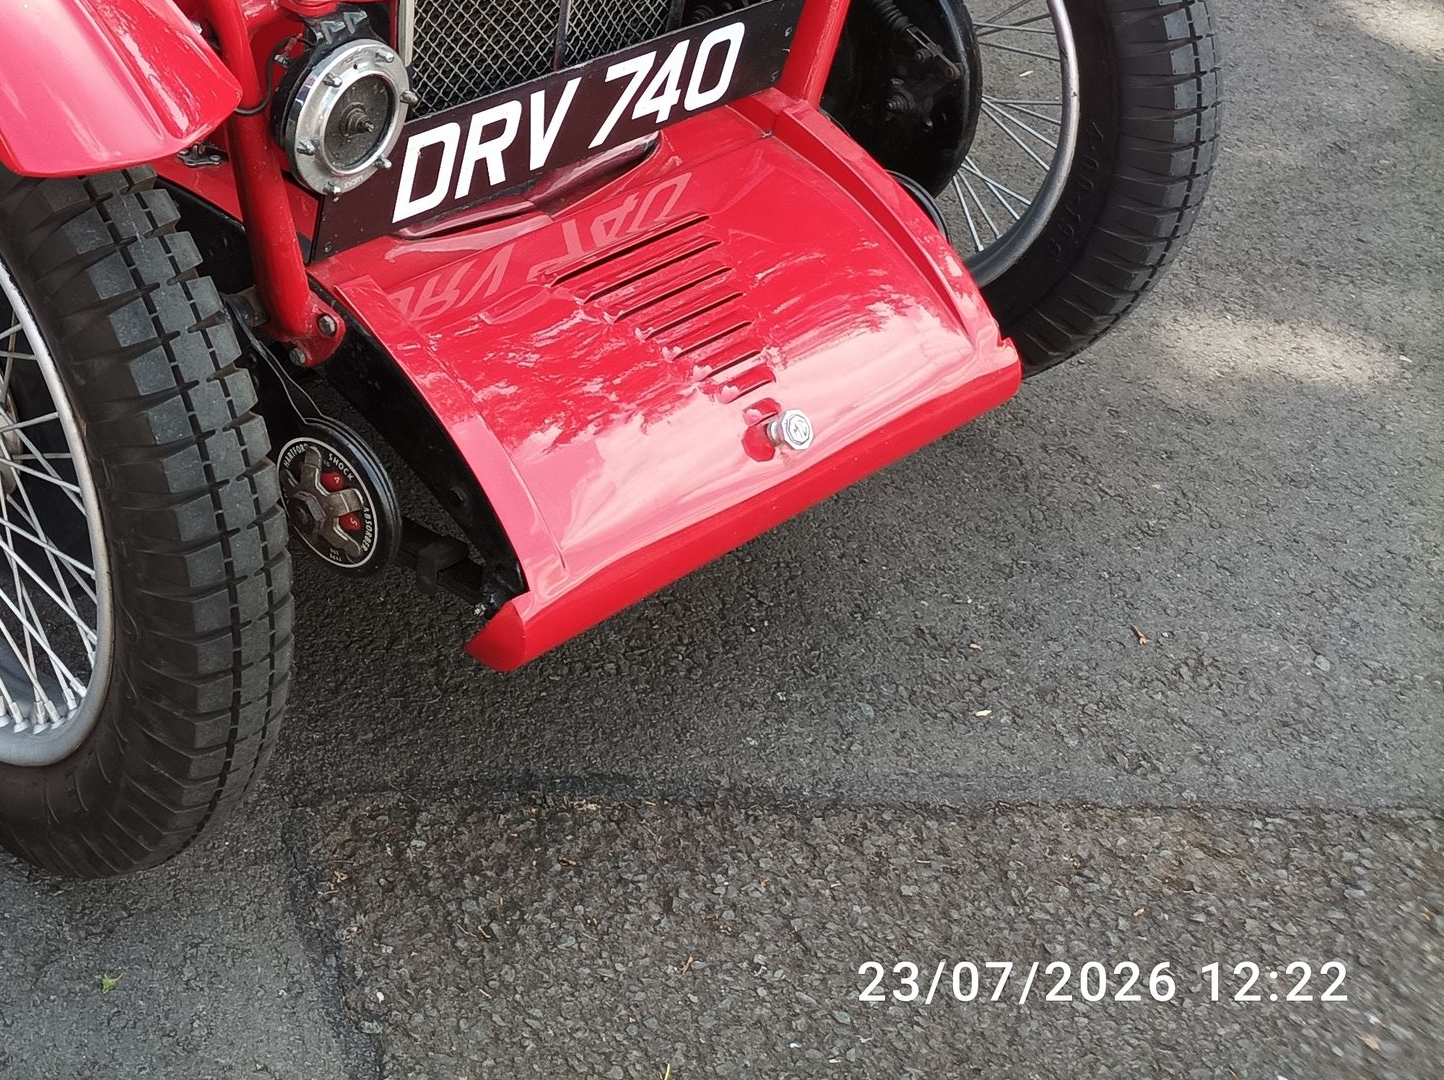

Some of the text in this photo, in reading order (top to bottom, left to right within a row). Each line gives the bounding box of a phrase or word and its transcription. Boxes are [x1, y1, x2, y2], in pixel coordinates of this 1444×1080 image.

[392, 22, 745, 224] DRV 740
[329, 453, 354, 481] SHOCK
[362, 506, 373, 552] ABSORBER
